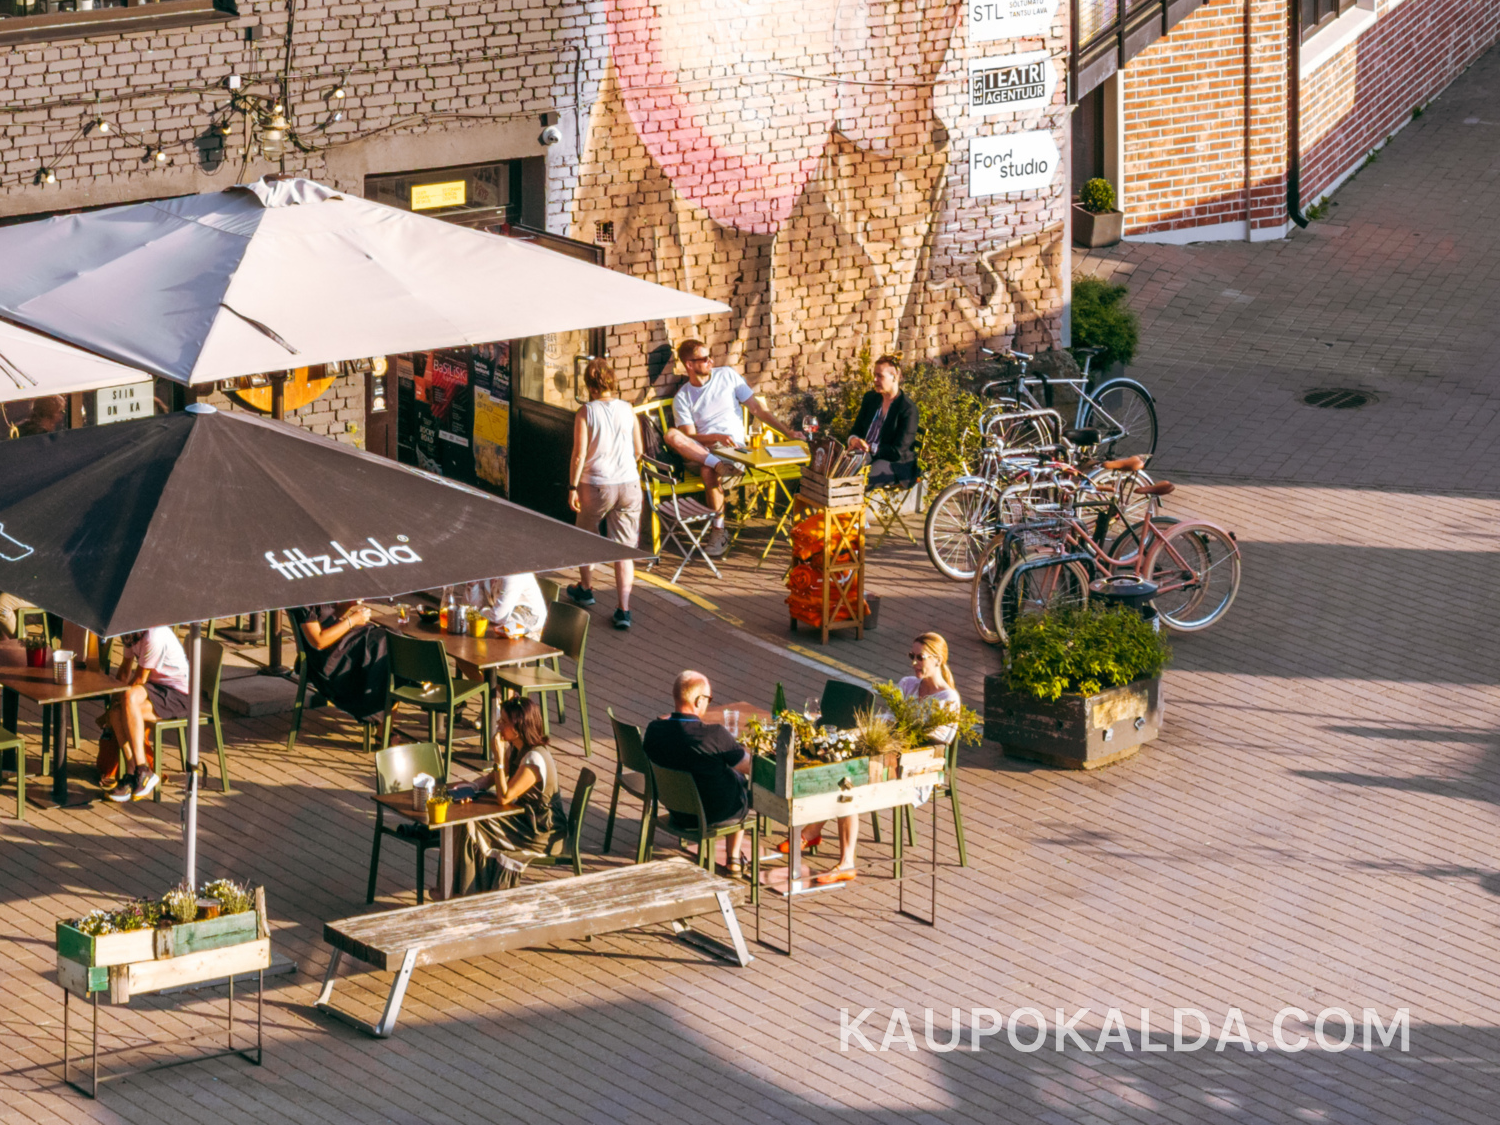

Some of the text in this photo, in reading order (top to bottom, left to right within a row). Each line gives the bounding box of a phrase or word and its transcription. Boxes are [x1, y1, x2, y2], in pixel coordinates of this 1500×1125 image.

[973, 3, 1004, 22] STL
[1009, 7, 1048, 18] TANTSU LAVA
[986, 63, 1044, 88] TEATRI
[986, 85, 1044, 104] AGENTUUR
[974, 148, 1013, 170] Food
[1000, 158, 1048, 178] studio
[113, 387, 134, 400] SIIN
[107, 402, 140, 416] ON KA
[264, 537, 423, 580] fritz-kola
